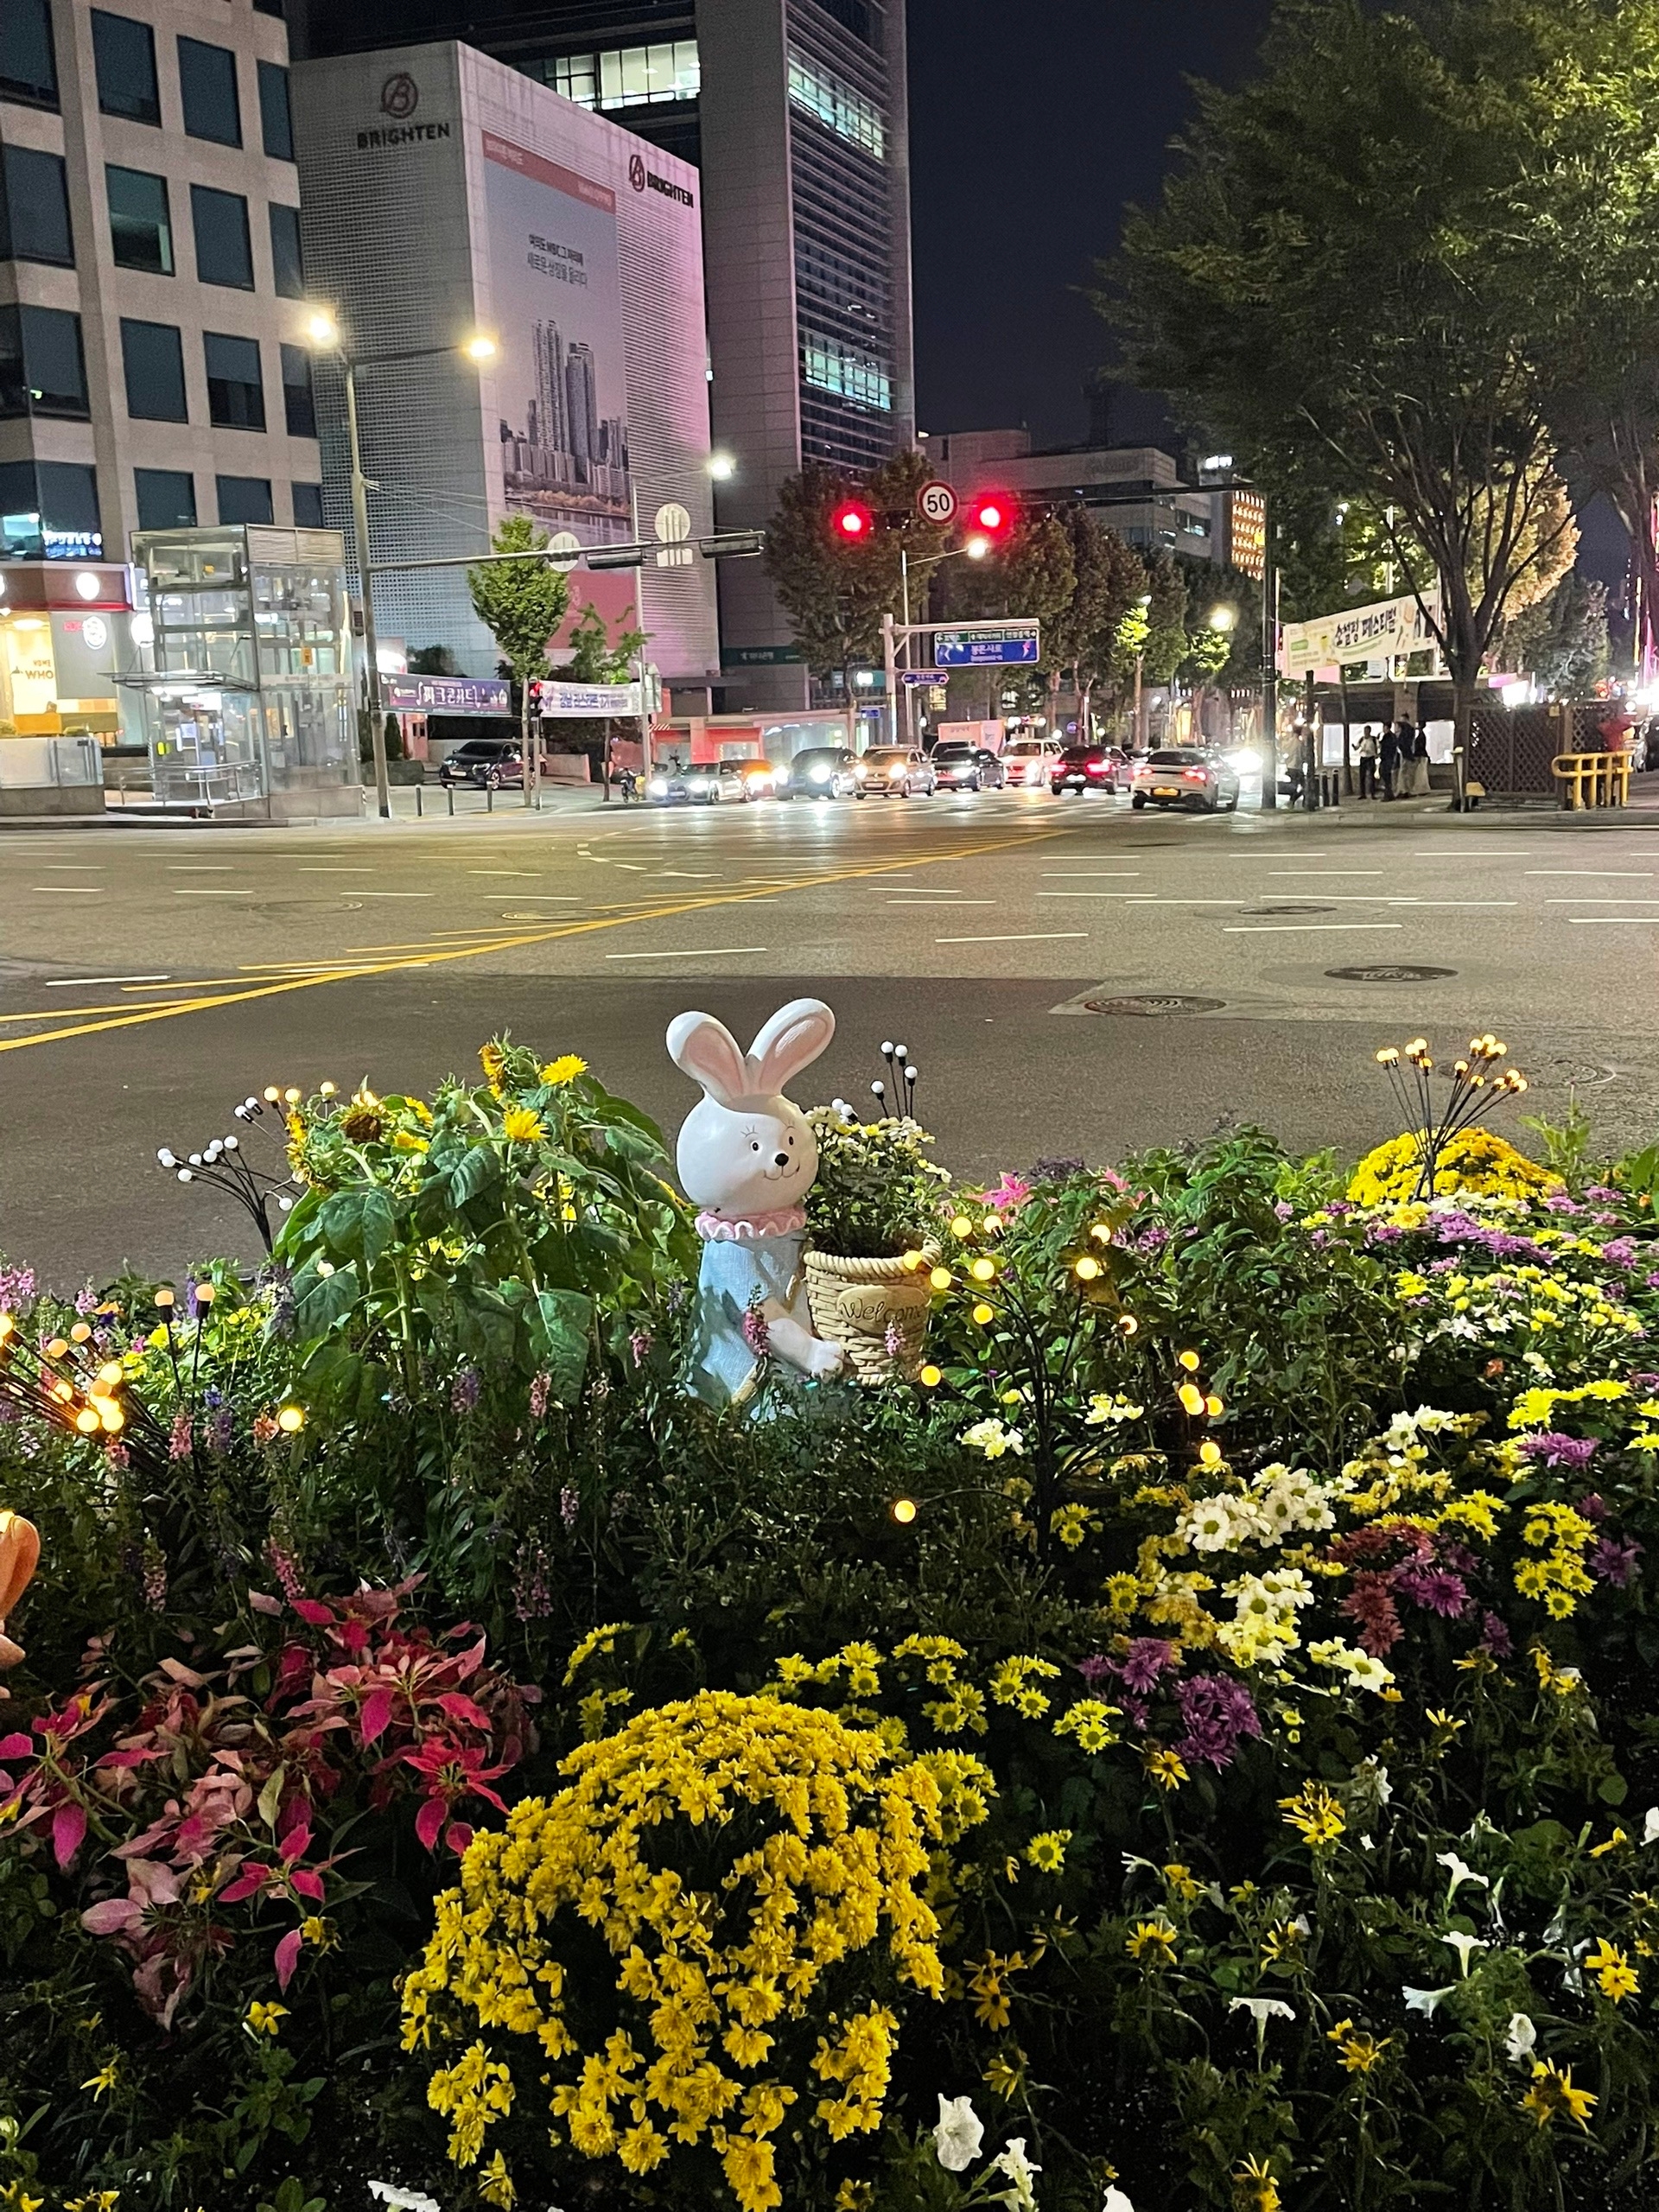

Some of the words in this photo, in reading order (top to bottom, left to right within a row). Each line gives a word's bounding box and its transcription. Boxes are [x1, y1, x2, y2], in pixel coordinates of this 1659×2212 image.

[357, 123, 449, 149] BRIGHTEN
[647, 171, 694, 208] BRIGHTEN
[927, 493, 950, 513] 50
